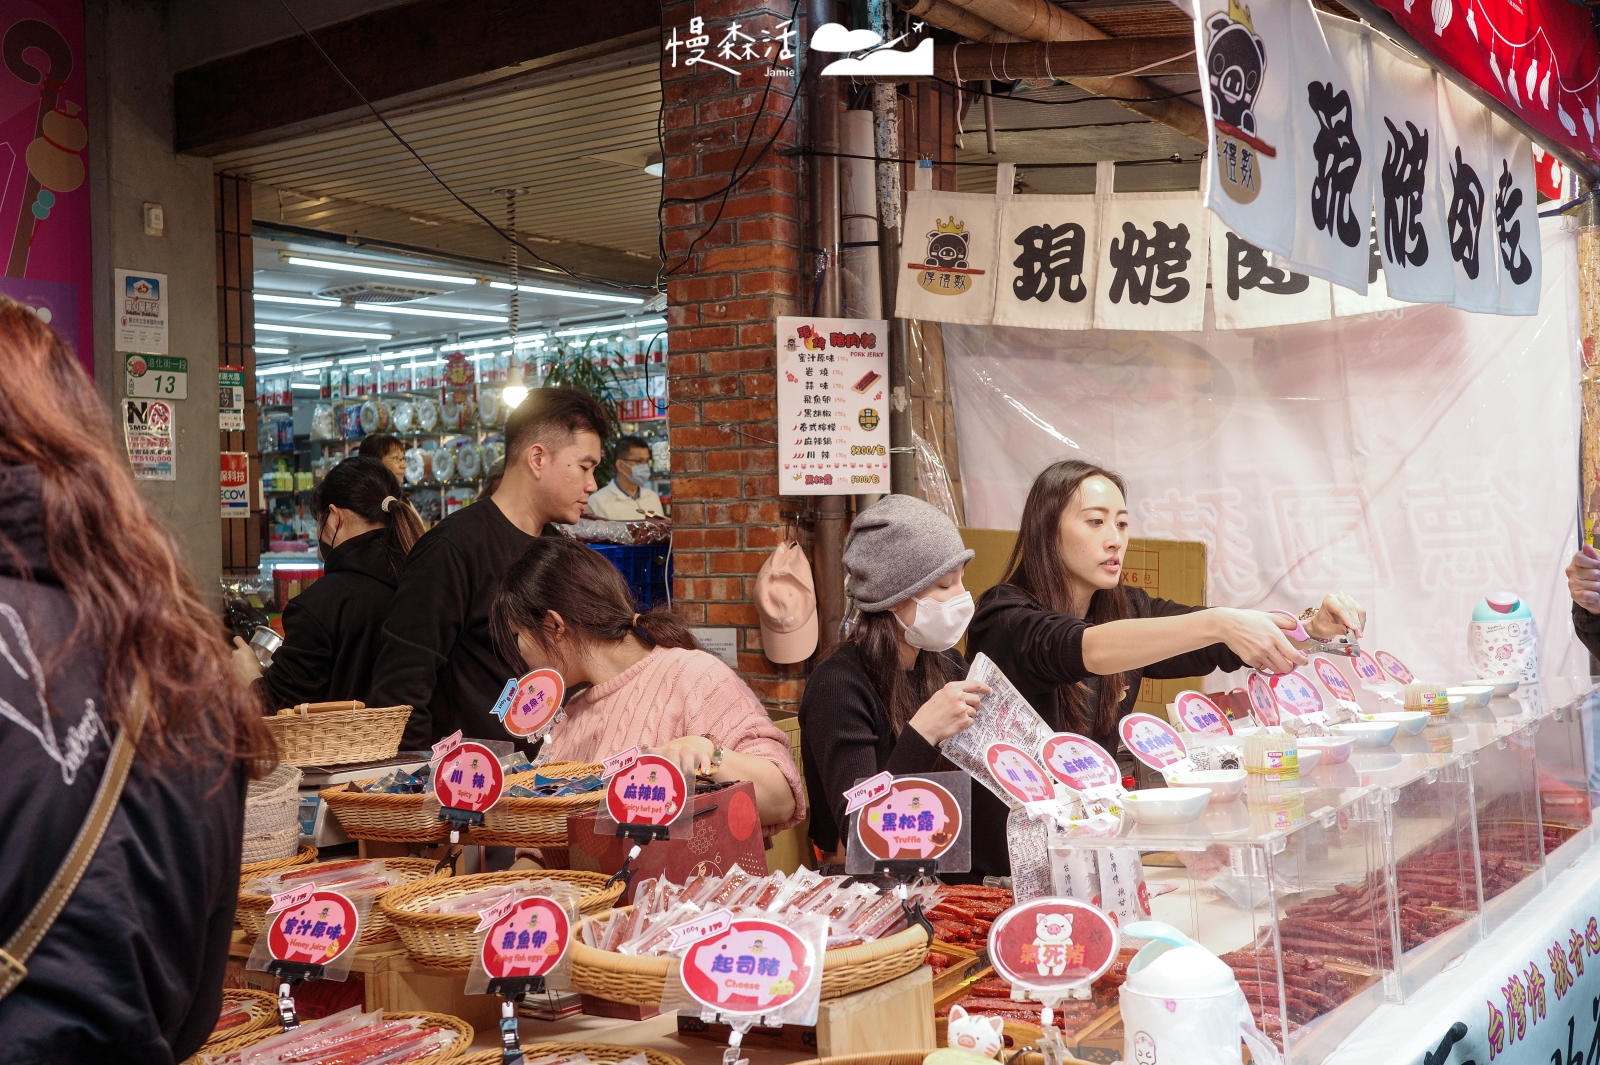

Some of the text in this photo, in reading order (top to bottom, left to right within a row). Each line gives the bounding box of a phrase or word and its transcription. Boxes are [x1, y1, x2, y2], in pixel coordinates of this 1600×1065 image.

[1216, 134, 1255, 192] 禮數
[797, 325, 877, 351] 現烤 豬肉乾
[798, 353, 835, 363] 蜜汁原味
[155, 375, 176, 394] 13
[803, 395, 831, 405] 飛魚卵
[804, 409, 832, 418] 黑胡椒
[800, 422, 837, 432] 泰式檸檬
[804, 437, 832, 446] 麻辣鍋
[851, 444, 886, 457] $200/包
[805, 474, 833, 485] 黑松露
[1062, 755, 1100, 774] 麻辣鍋
[451, 769, 484, 789] 川辣
[457, 789, 472, 800] Spicy
[623, 782, 666, 803] 麻辣鍋
[623, 802, 663, 816] Spicy hot pot
[881, 811, 935, 833] 黑松露
[893, 835, 921, 844] Truffle
[283, 917, 343, 941] 蜜汁原味
[290, 938, 327, 952] Honey juice
[502, 929, 547, 950] 飛魚卵
[493, 953, 543, 965] Flying fish eggs
[1019, 943, 1086, 966] 氣死豬
[711, 953, 780, 977] 起司豬
[725, 979, 760, 990] Cheese
